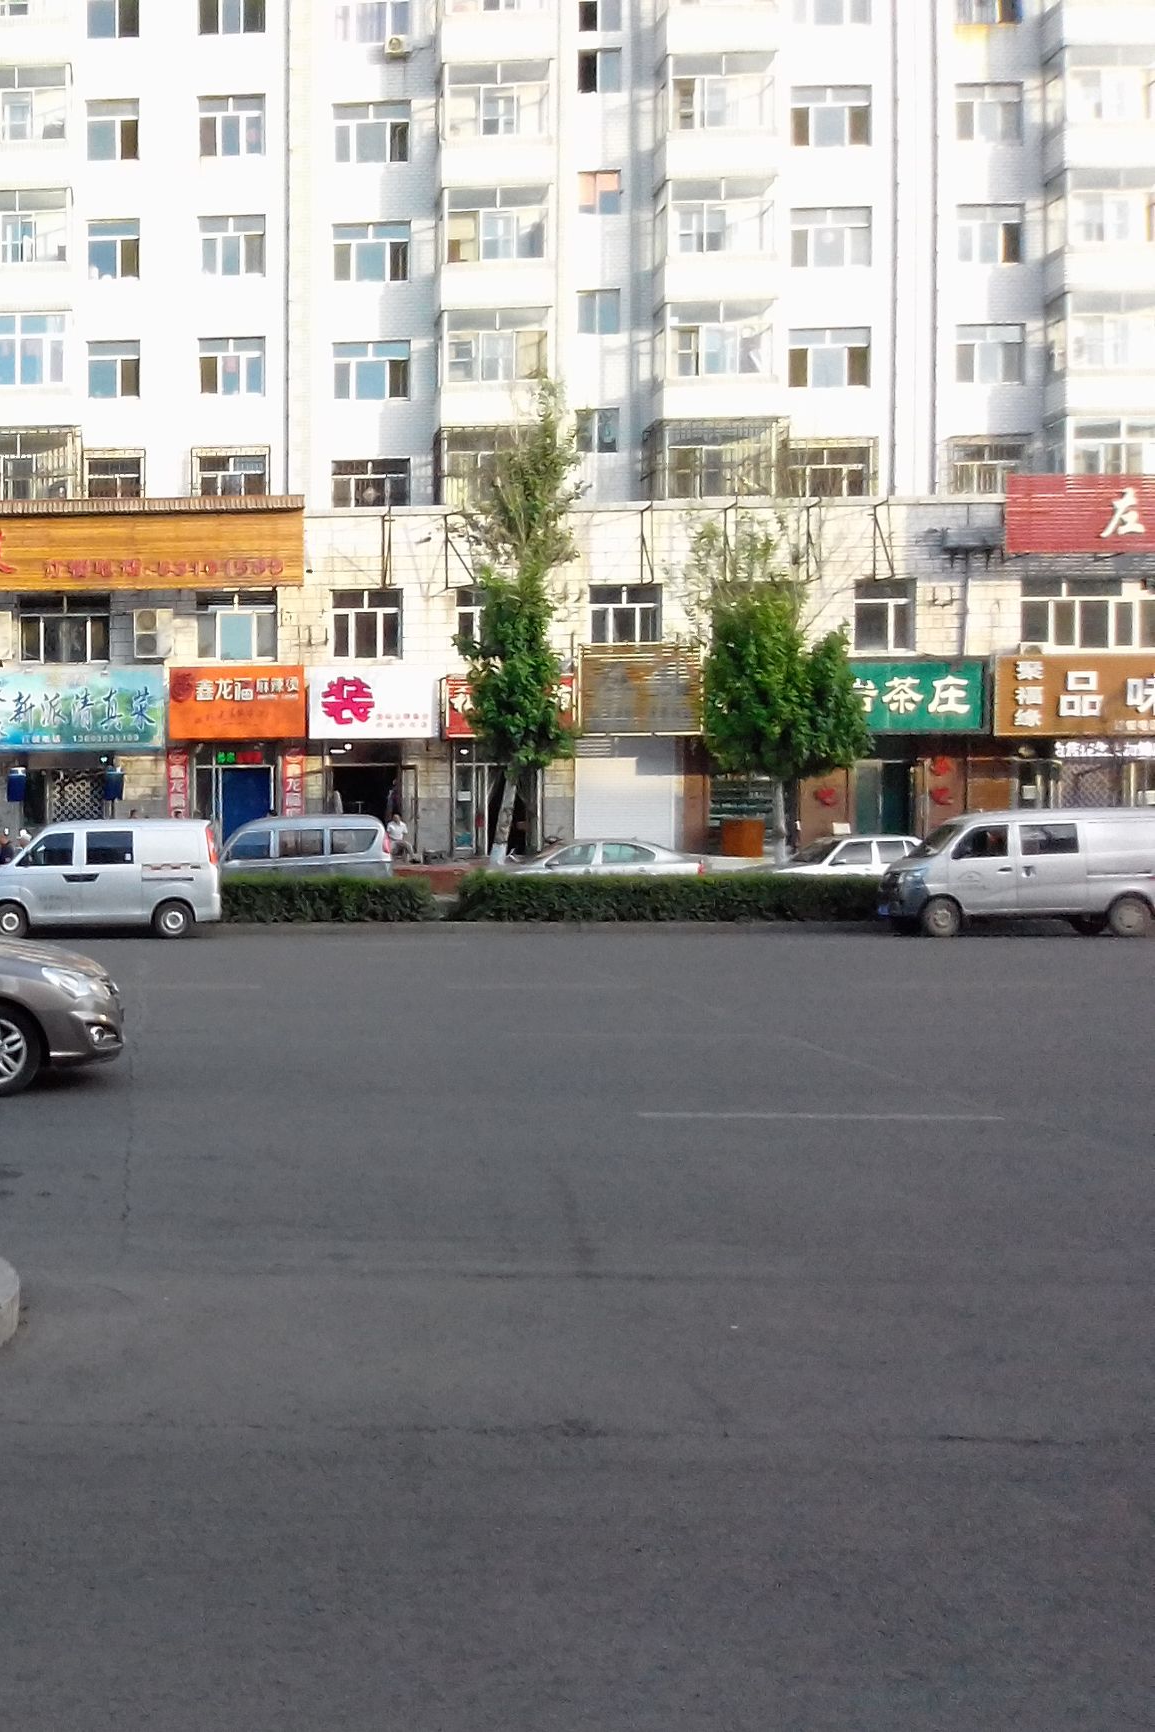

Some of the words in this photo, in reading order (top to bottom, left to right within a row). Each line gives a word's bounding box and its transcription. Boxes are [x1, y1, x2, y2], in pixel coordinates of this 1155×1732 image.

[9, 684, 157, 732] 新派清真菜
